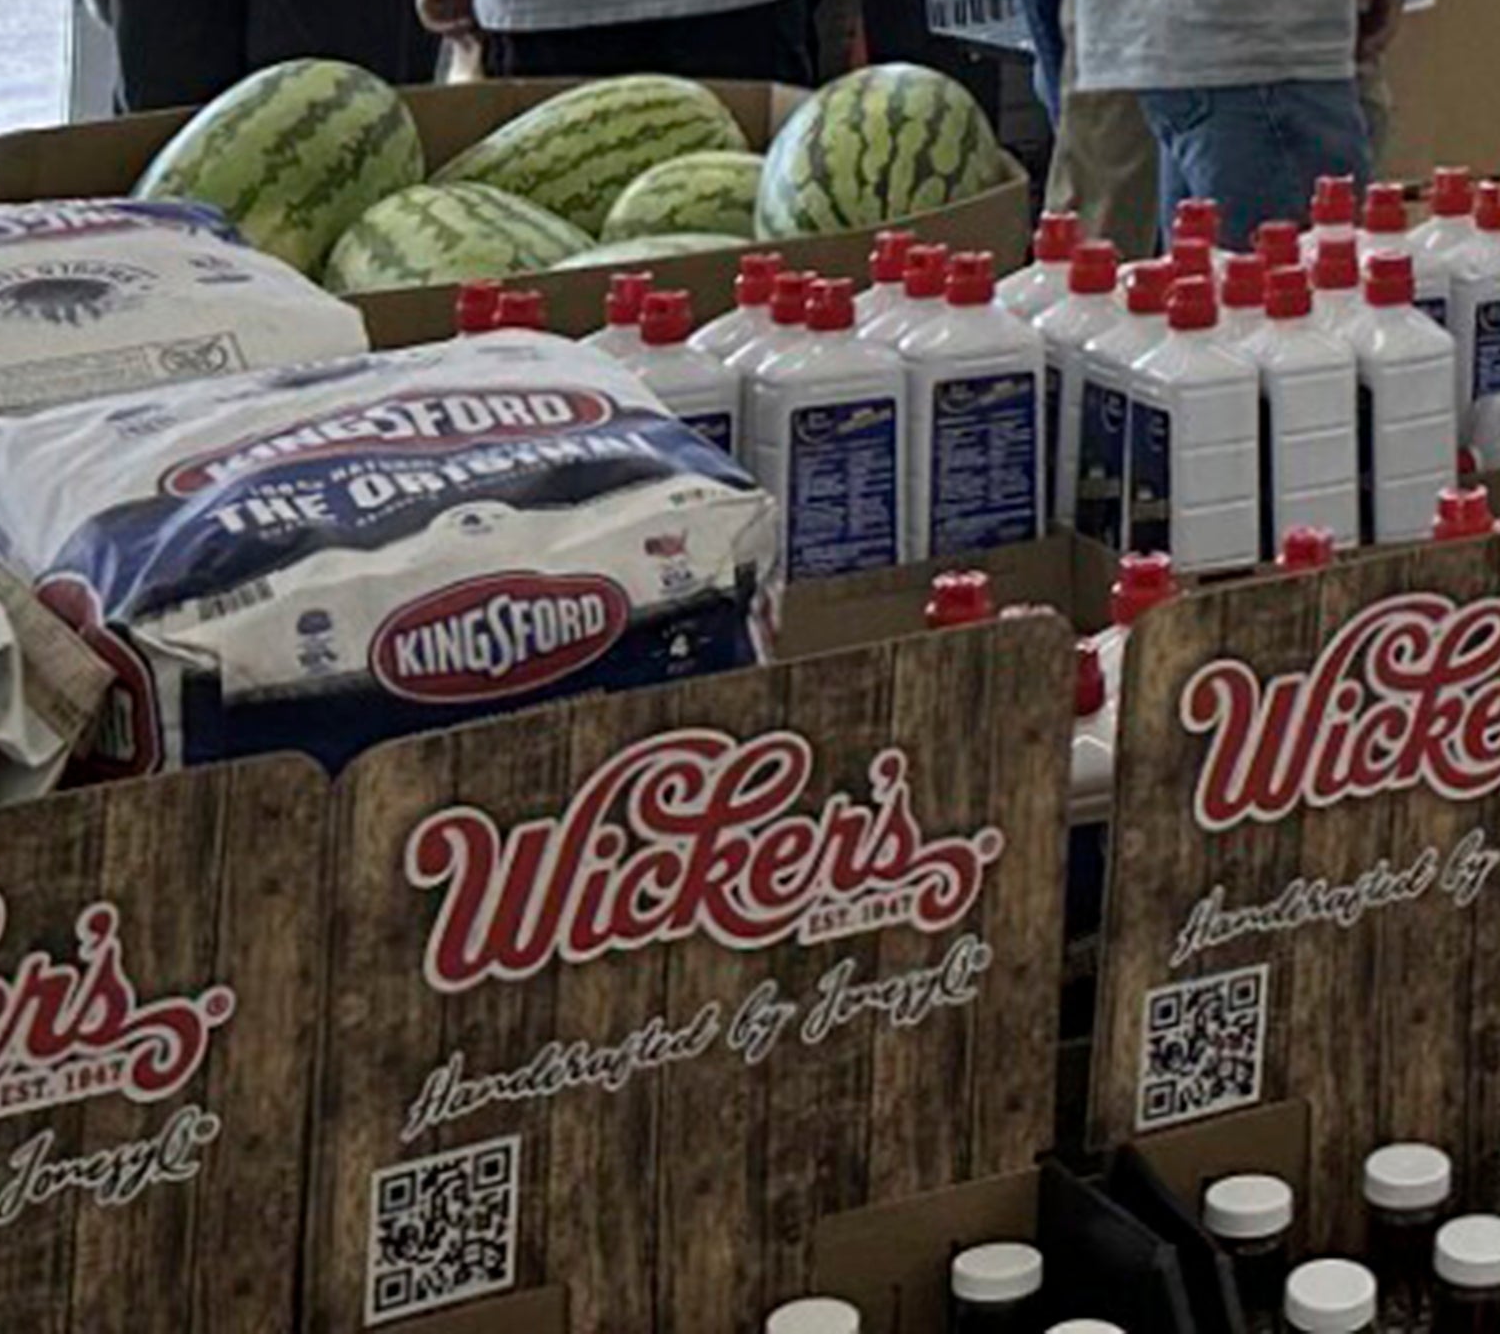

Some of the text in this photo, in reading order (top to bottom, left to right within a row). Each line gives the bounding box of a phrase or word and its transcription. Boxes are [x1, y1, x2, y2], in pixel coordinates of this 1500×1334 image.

[204, 391, 573, 481] KINGSFORD
[208, 493, 338, 535] THE
[395, 593, 606, 677] KINGSFORD
[669, 634, 689, 657] 4
[404, 729, 1004, 993] Wicker's
[1168, 846, 1435, 967] Handcrafted
[1440, 828, 1500, 906] by
[399, 1002, 719, 1141] Handcrafted
[728, 979, 795, 1063] by
